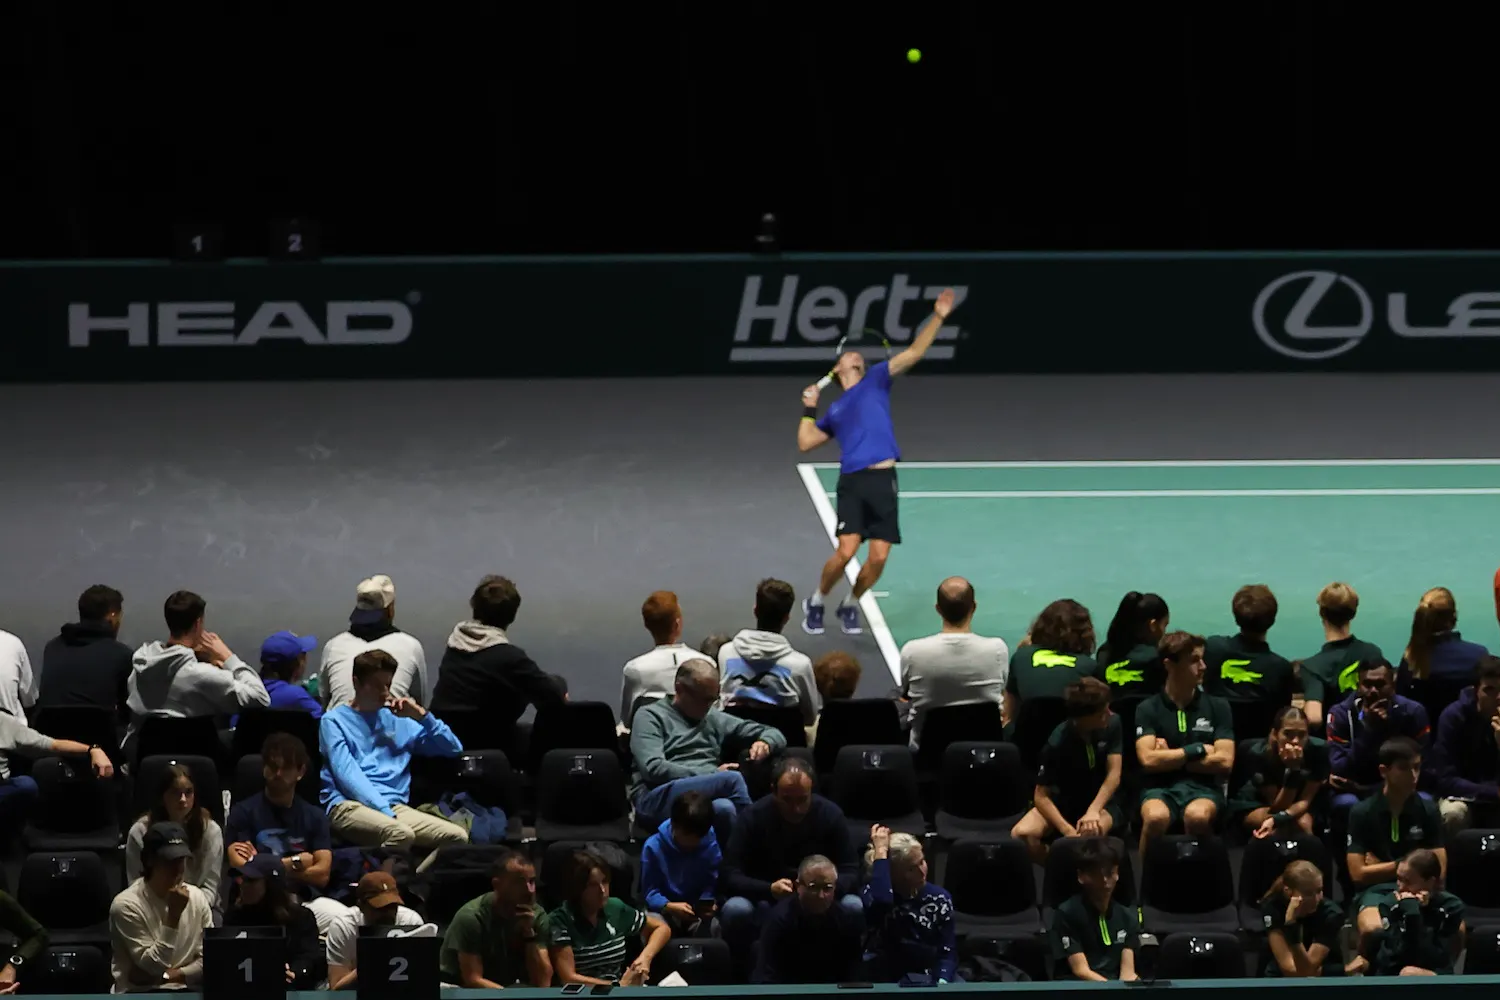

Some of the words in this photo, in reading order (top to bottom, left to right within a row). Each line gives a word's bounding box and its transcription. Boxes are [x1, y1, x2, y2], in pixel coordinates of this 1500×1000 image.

[191, 235, 203, 253] 1
[287, 234, 303, 253] 2
[733, 273, 969, 342] Hertz
[69, 301, 413, 347] HEAD
[237, 957, 253, 983] 1
[388, 956, 409, 982] 2
